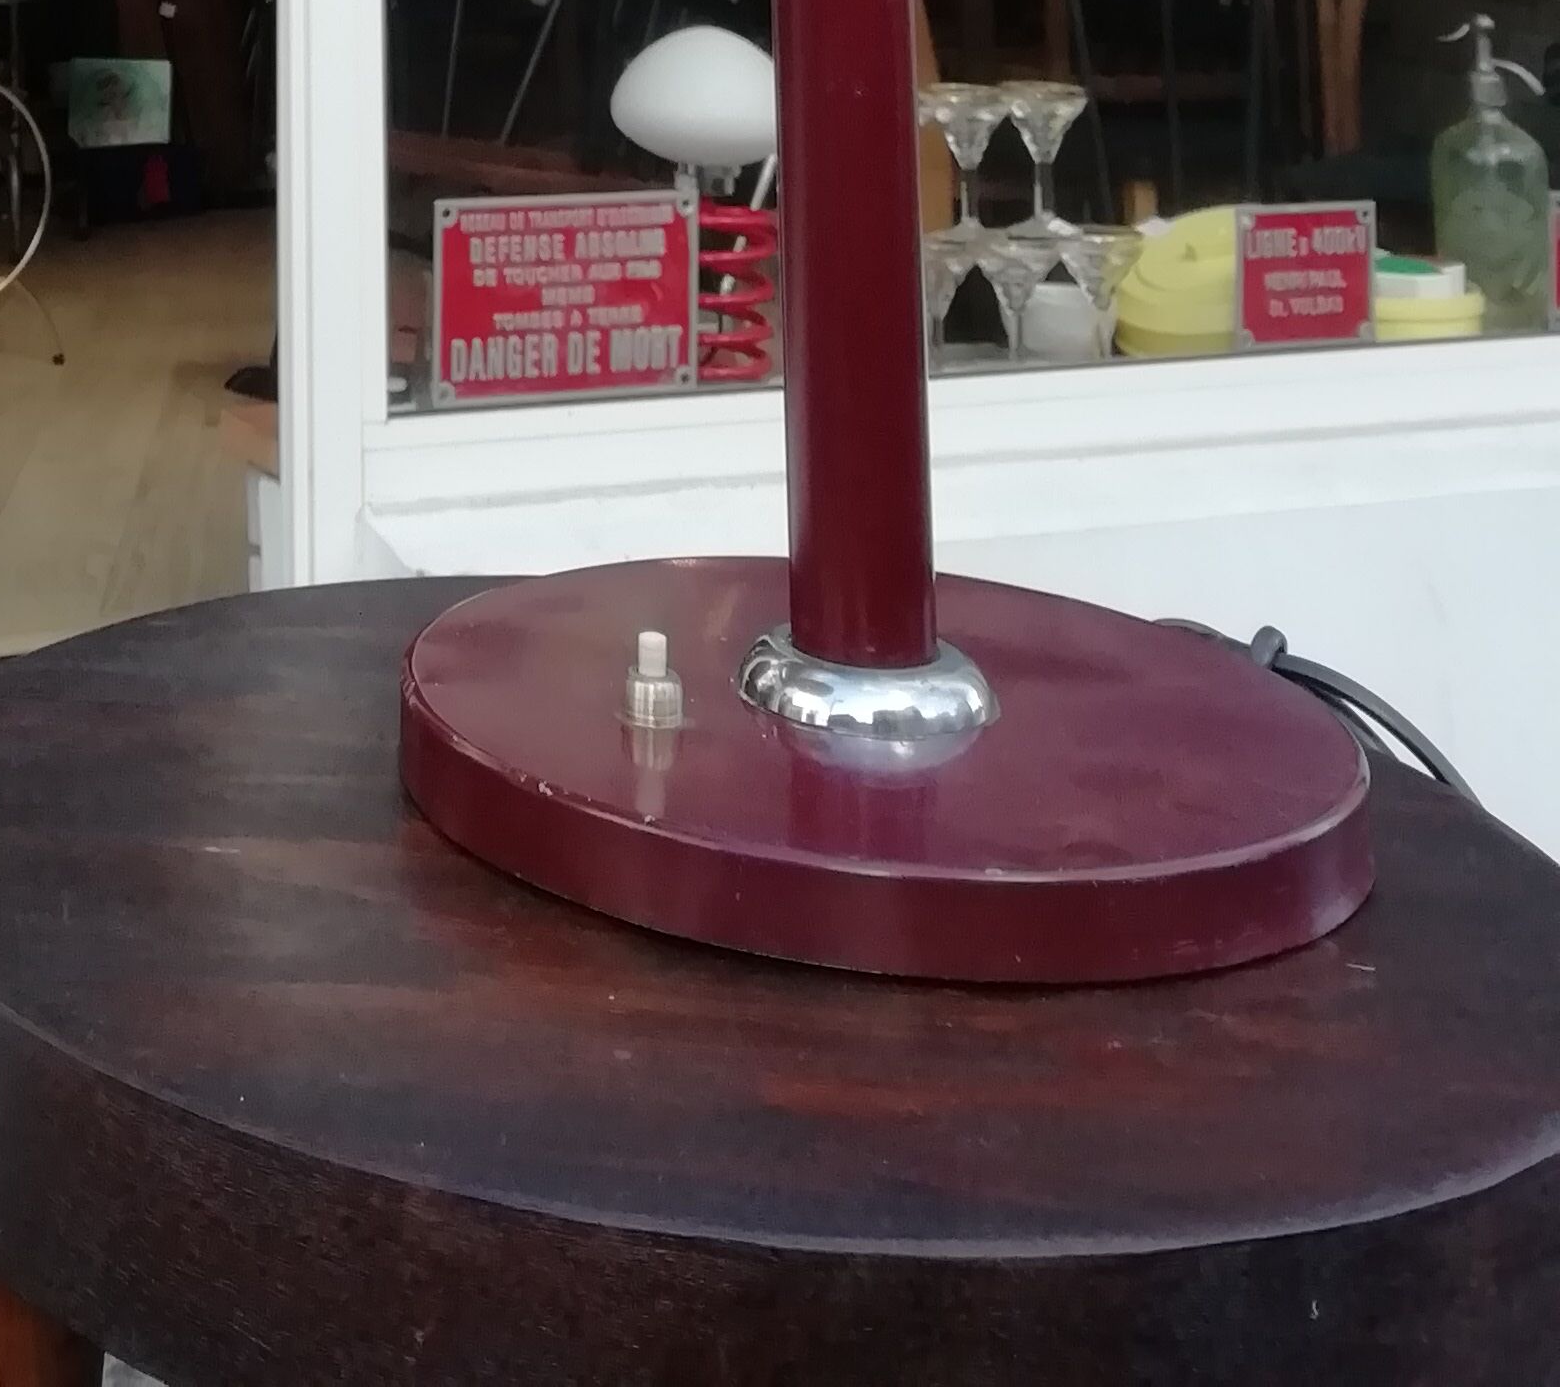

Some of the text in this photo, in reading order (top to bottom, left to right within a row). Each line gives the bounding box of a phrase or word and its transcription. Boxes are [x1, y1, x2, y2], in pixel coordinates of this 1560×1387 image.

[469, 233, 566, 265] DEFENSE
[450, 332, 559, 384] DANGER
[567, 329, 603, 376] DE
